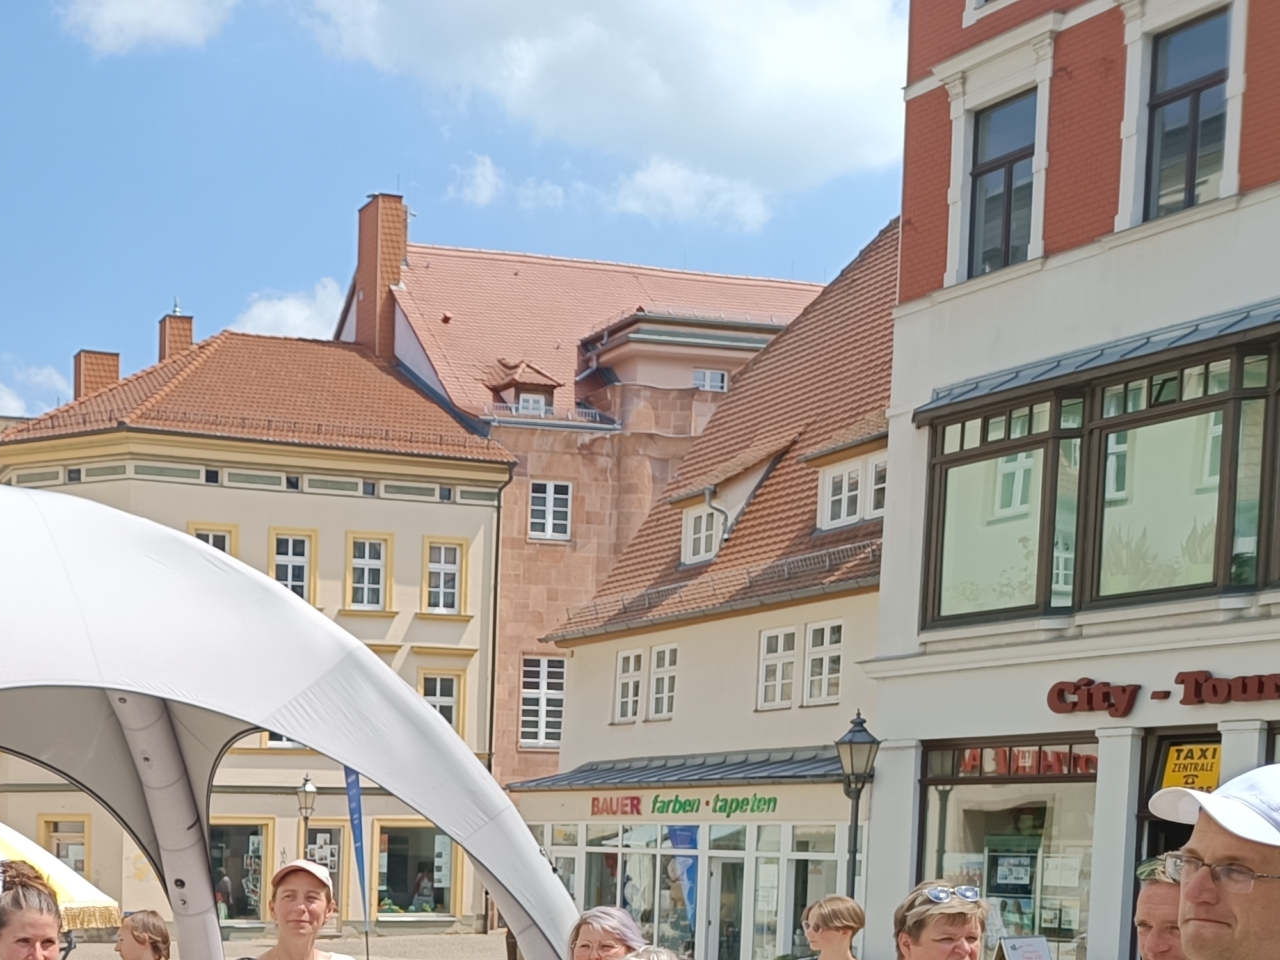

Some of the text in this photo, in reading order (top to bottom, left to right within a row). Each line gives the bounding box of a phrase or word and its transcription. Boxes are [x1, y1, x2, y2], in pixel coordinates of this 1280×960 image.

[1047, 677, 1142, 718] City
[1175, 747, 1218, 761] TAXI
[1171, 761, 1215, 774] ZENTRALE
[591, 793, 778, 818] BAUER farben tapeten
